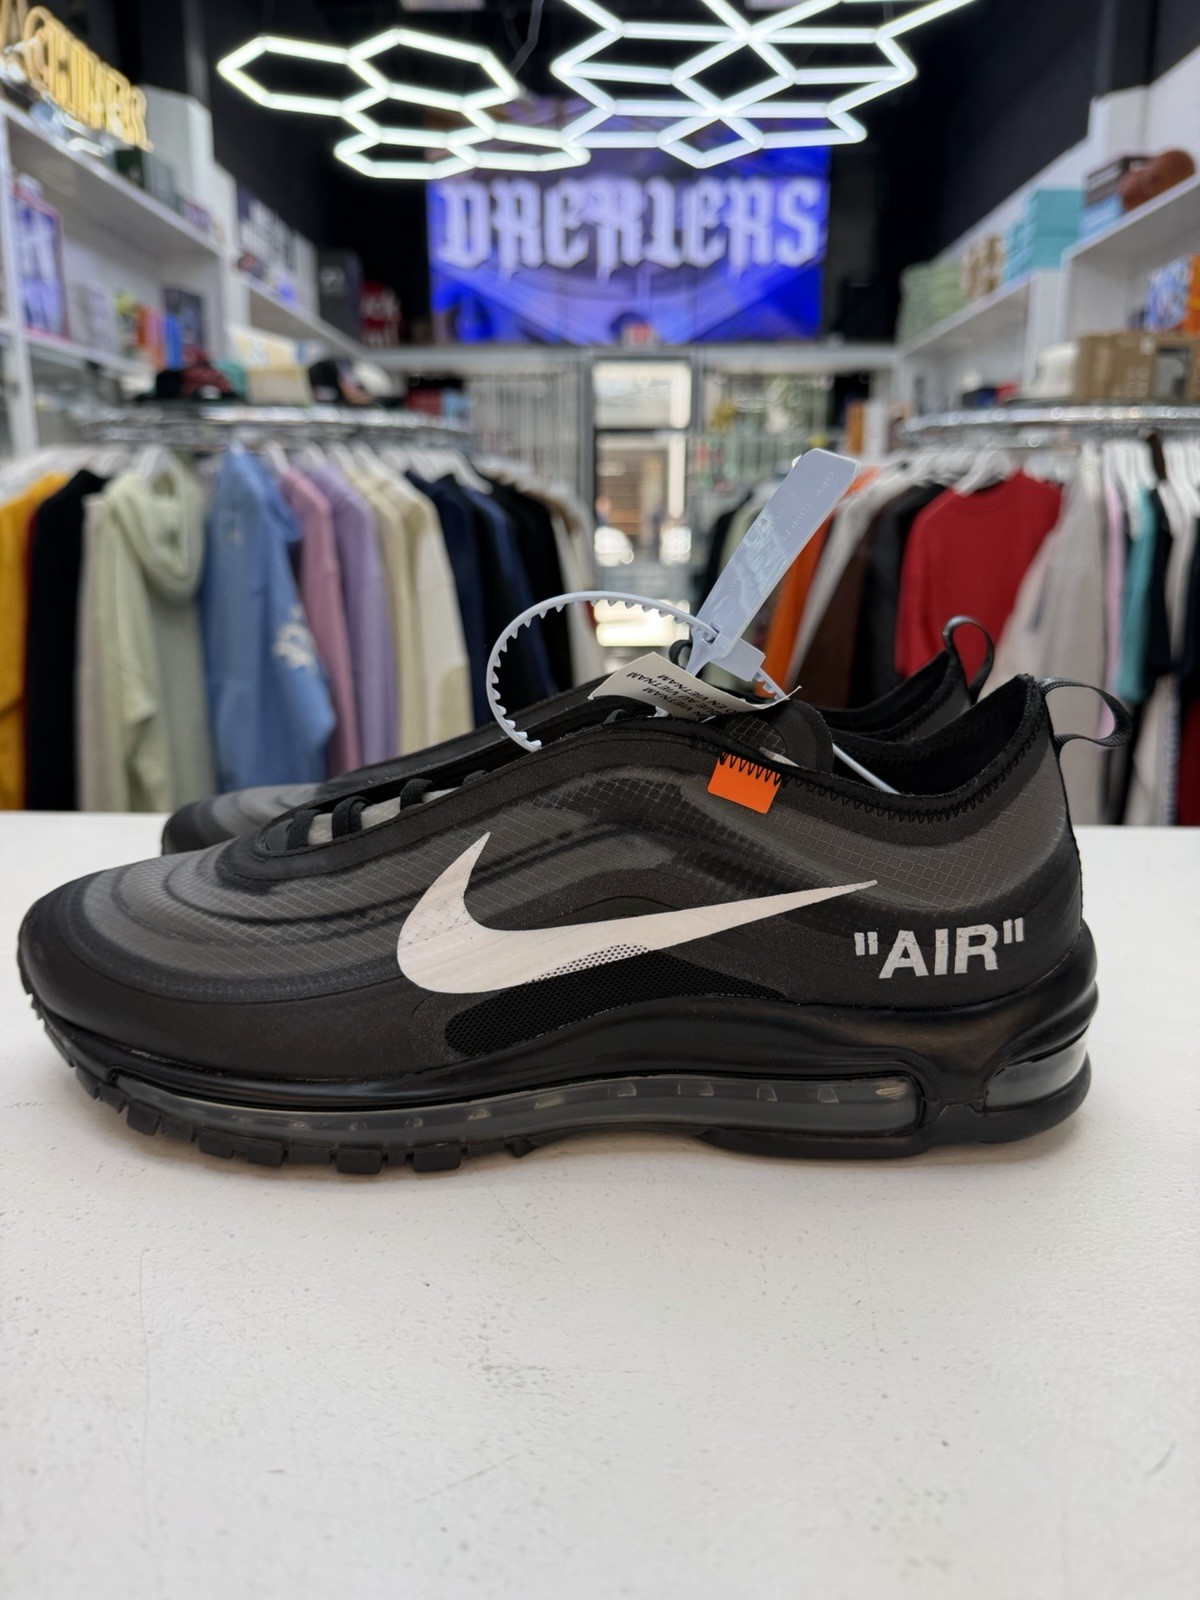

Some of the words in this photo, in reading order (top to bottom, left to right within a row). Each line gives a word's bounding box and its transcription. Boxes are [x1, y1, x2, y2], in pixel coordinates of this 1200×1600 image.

[626, 671, 679, 695] VIETNAM
[657, 674, 709, 701] VIETNAM
[642, 687, 693, 711] VIETNAM
[853, 917, 1025, 979] "AIR"
